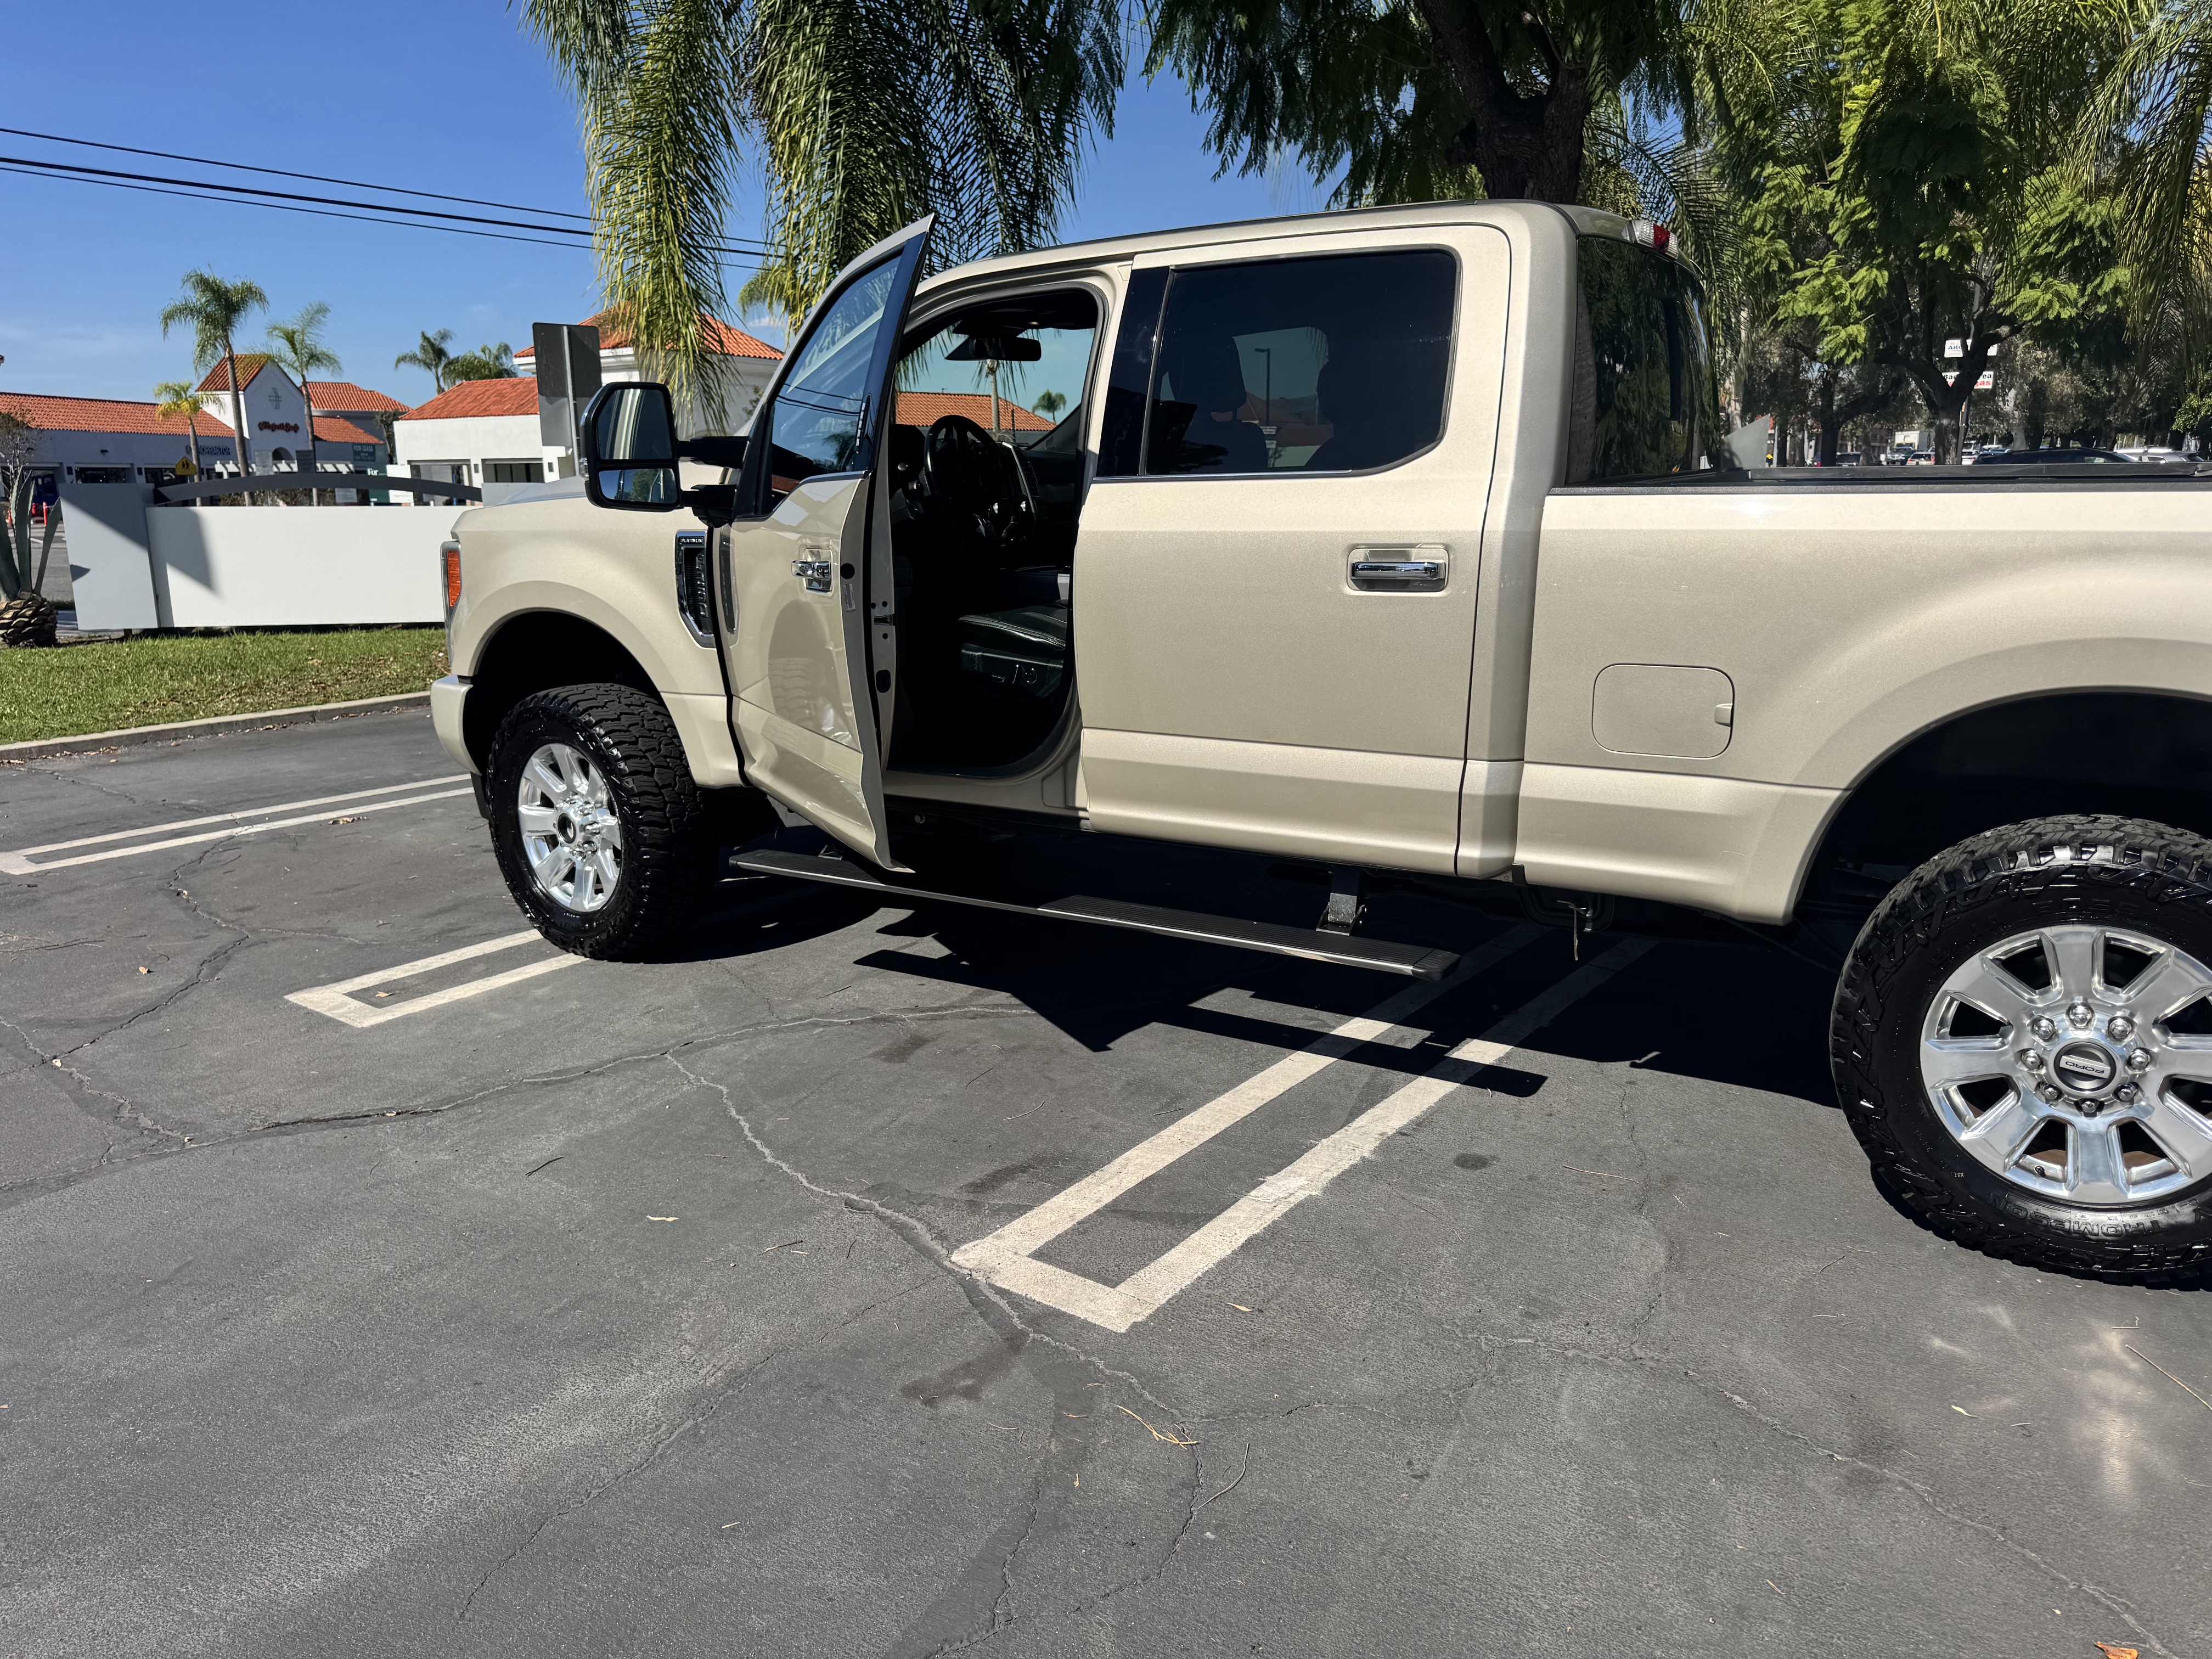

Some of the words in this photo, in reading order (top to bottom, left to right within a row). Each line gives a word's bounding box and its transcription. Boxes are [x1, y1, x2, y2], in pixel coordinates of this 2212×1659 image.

[367, 468, 379, 476] For
[2065, 1061, 2105, 1074] FORD
[1987, 1192, 2168, 1237] THOMPSON
